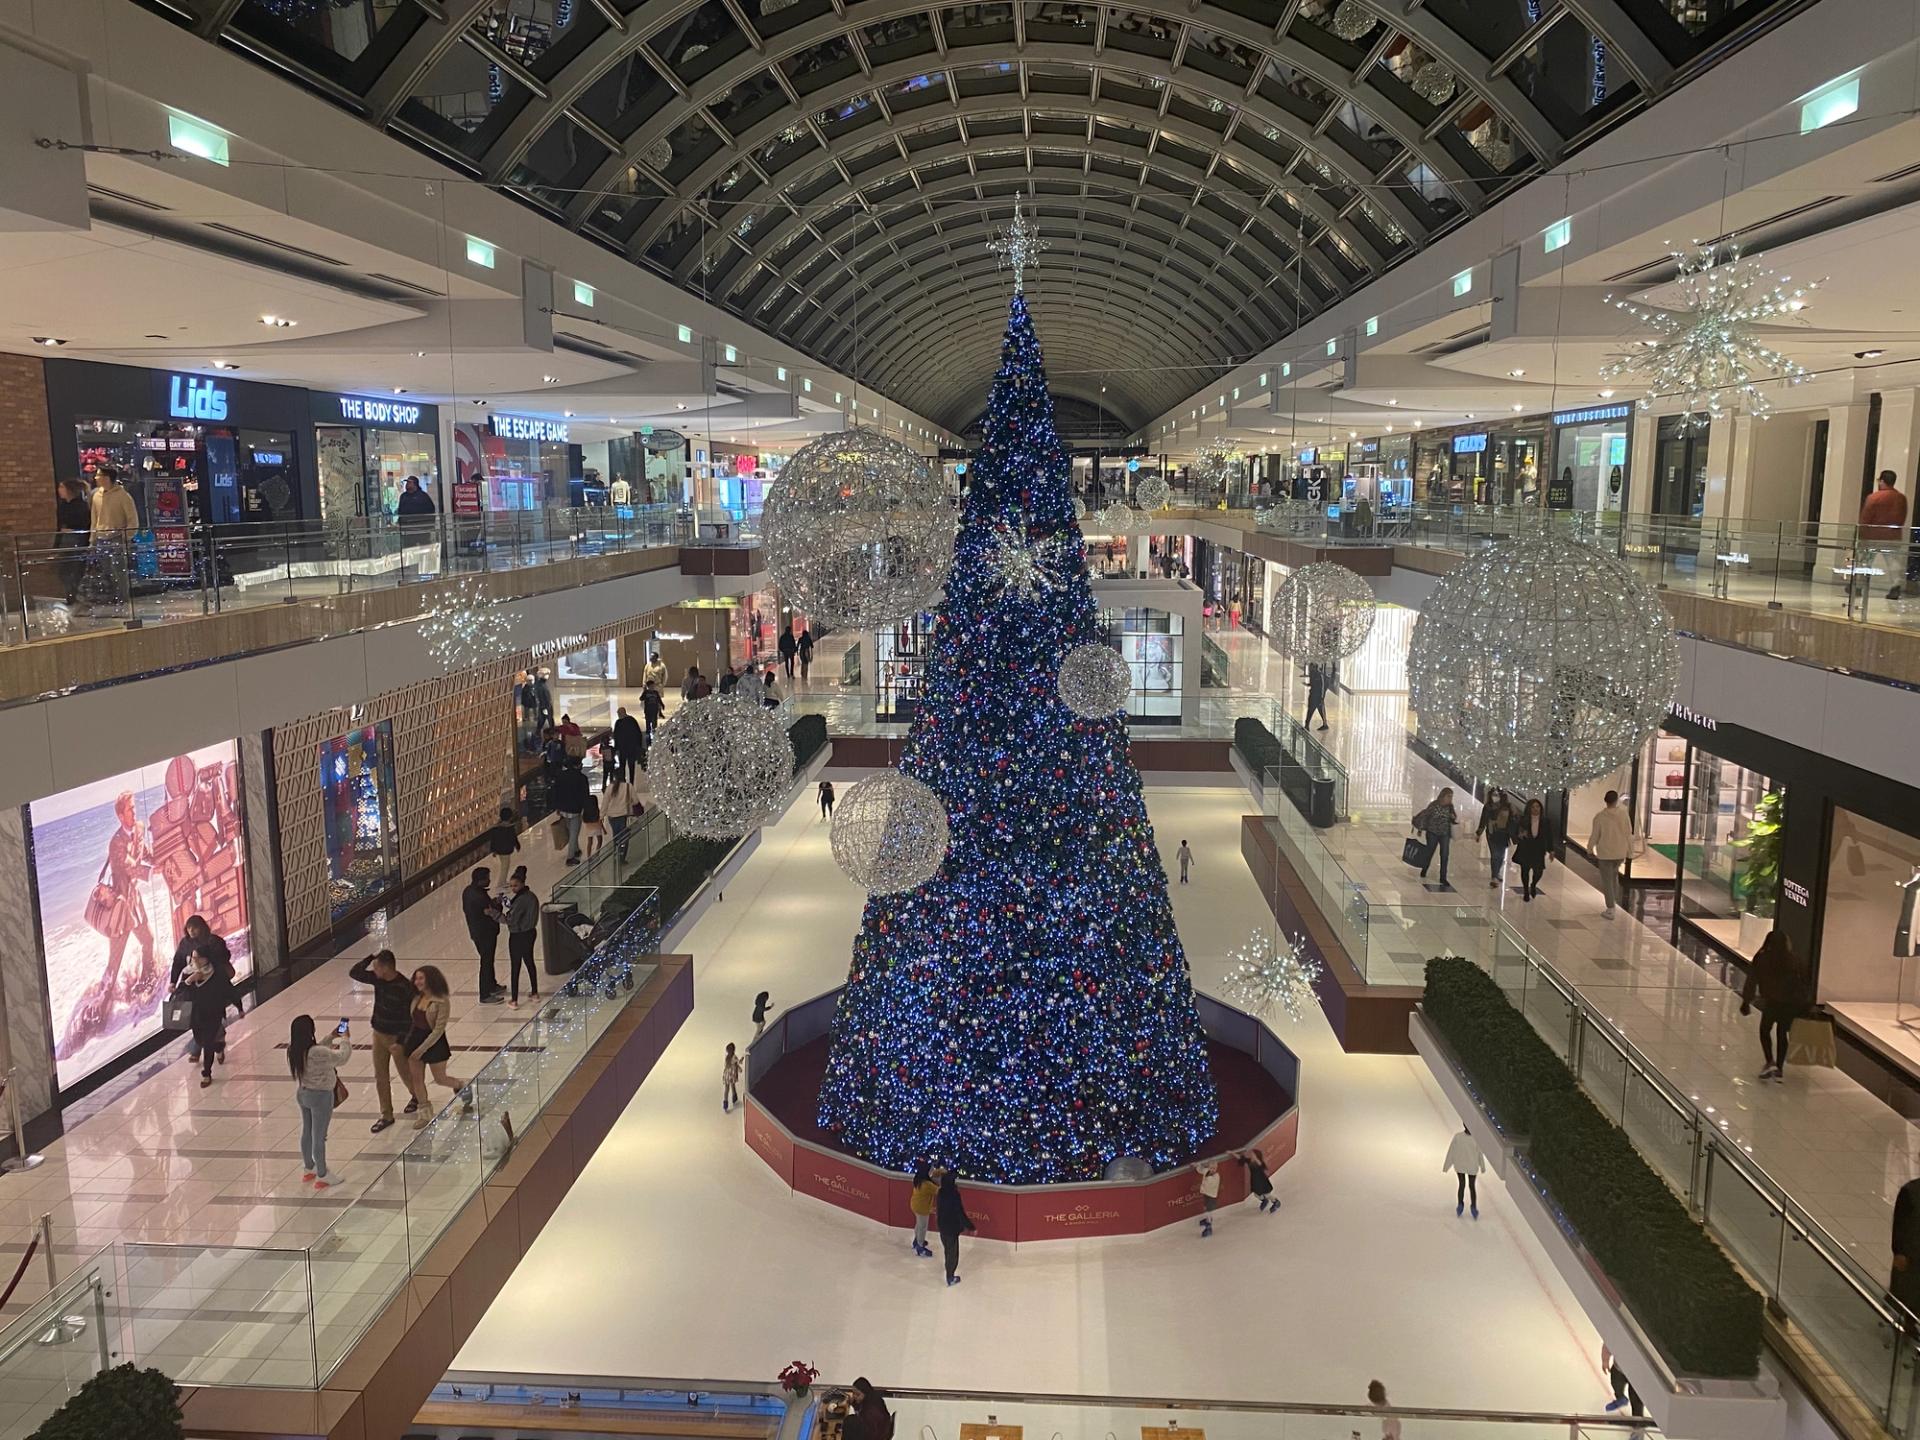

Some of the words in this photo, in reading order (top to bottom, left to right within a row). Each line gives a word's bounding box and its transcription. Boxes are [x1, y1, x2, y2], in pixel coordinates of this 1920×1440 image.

[170, 375, 228, 421] Lids
[340, 398, 363, 419] THE
[363, 401, 391, 422] BODY
[392, 404, 419, 425] SHOP
[493, 416, 513, 438] THE
[512, 419, 547, 441] ESCAPE
[546, 422, 569, 443] GAME
[214, 473, 233, 487] Lids
[1783, 877, 1809, 899] BOTTEGA
[1784, 887, 1807, 907] VENETA
[814, 1173, 831, 1187] THE
[830, 1180, 870, 1200] GALLERIA
[1167, 1197, 1184, 1208] THE
[966, 1210, 991, 1222] ERIA
[1044, 1213, 1067, 1223] THE
[1067, 1210, 1121, 1222] GALLERIA
